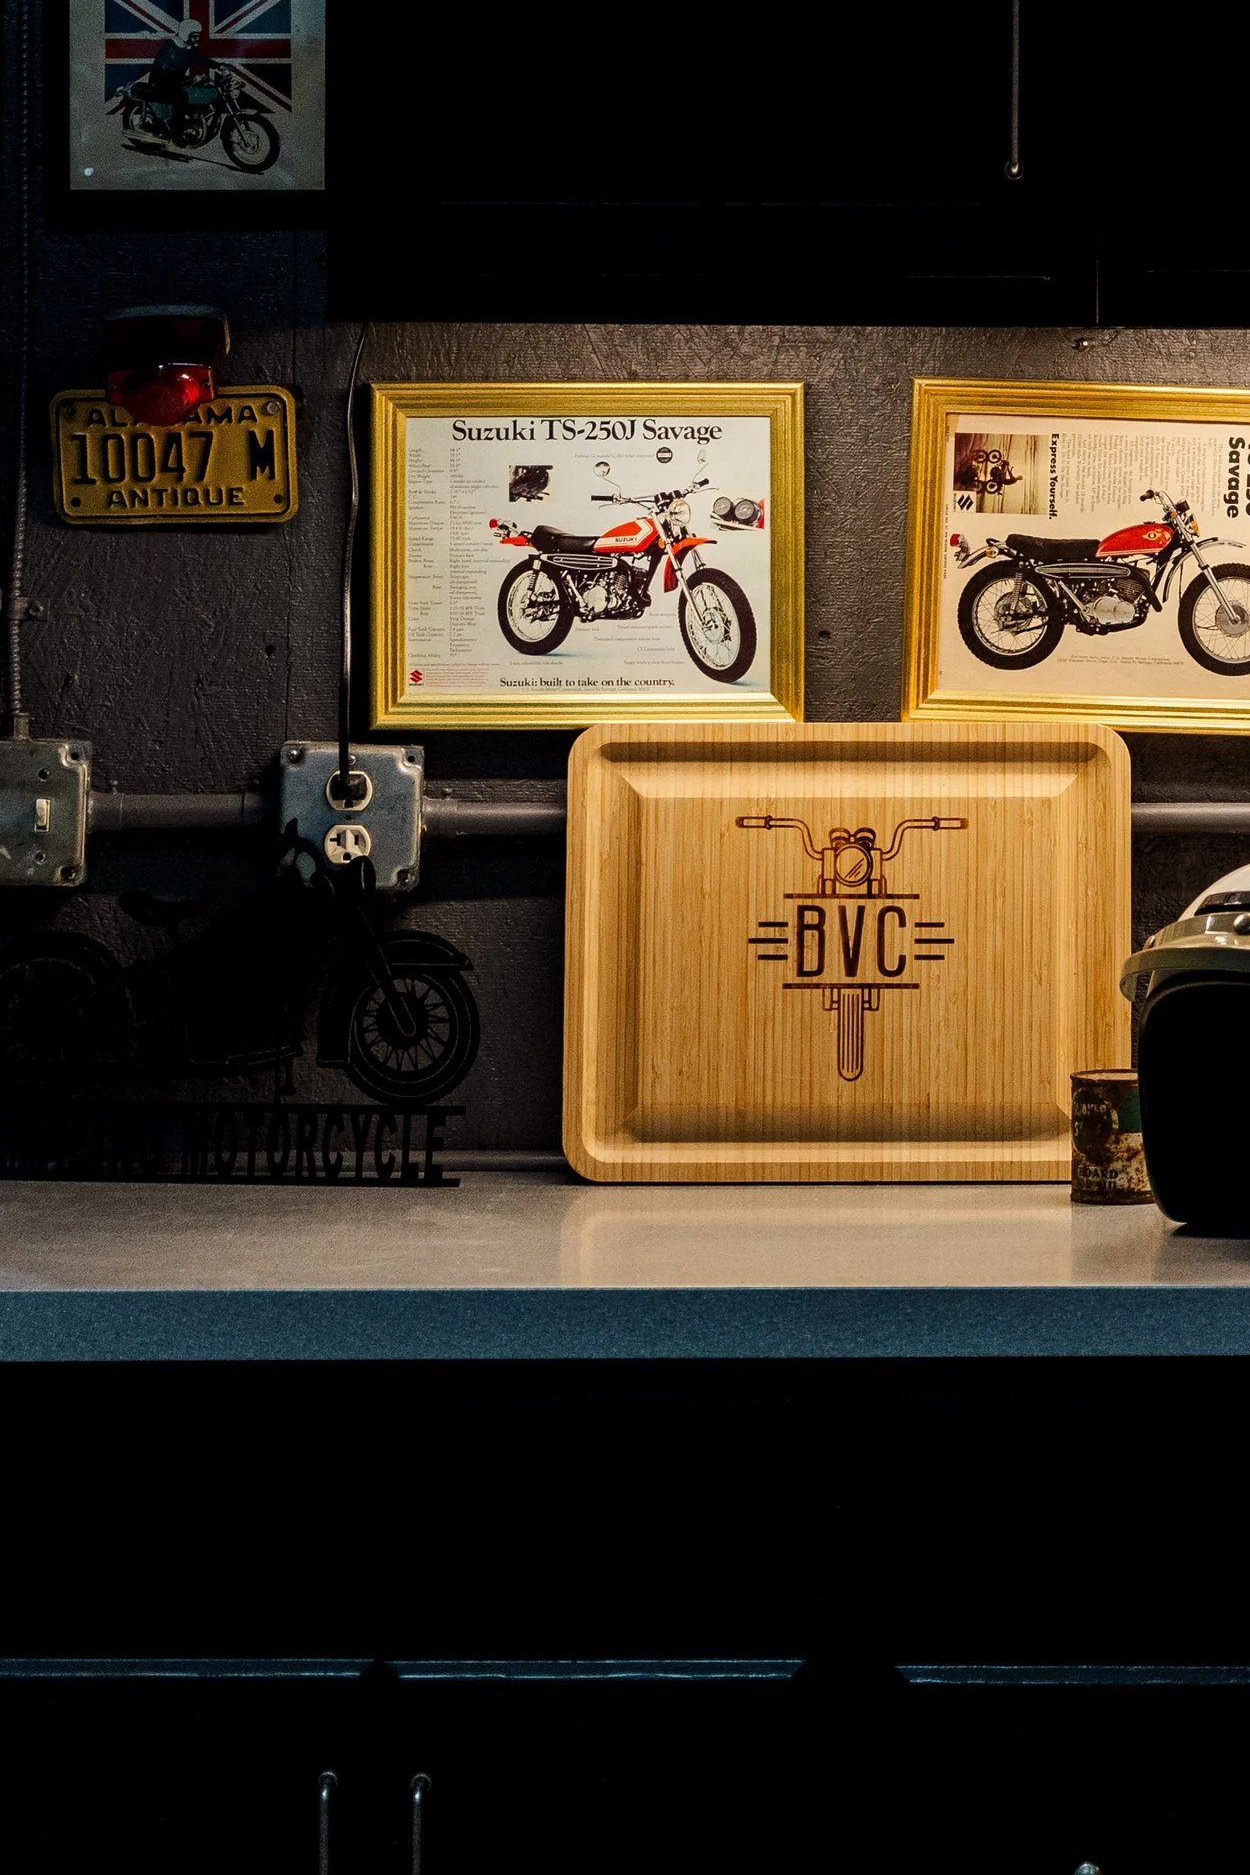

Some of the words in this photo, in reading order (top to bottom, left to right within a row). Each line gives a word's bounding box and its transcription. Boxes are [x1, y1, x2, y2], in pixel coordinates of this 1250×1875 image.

[452, 419, 536, 441] Suzuki
[540, 419, 636, 441] TS-250J
[643, 419, 723, 445] Savage
[1049, 433, 1060, 474] Express
[71, 430, 214, 485] 10047
[249, 428, 276, 482] M
[1223, 436, 1246, 519] Savage
[108, 487, 246, 508] ANTIQUE
[1048, 475, 1059, 520] Yourself.
[499, 677, 537, 687] Suzuki:
[539, 677, 563, 687] built
[565, 678, 576, 687] to
[577, 677, 599, 687] take
[601, 679, 614, 687] on
[616, 677, 632, 687] the
[634, 679, 675, 688] country.
[795, 904, 908, 978] BVC
